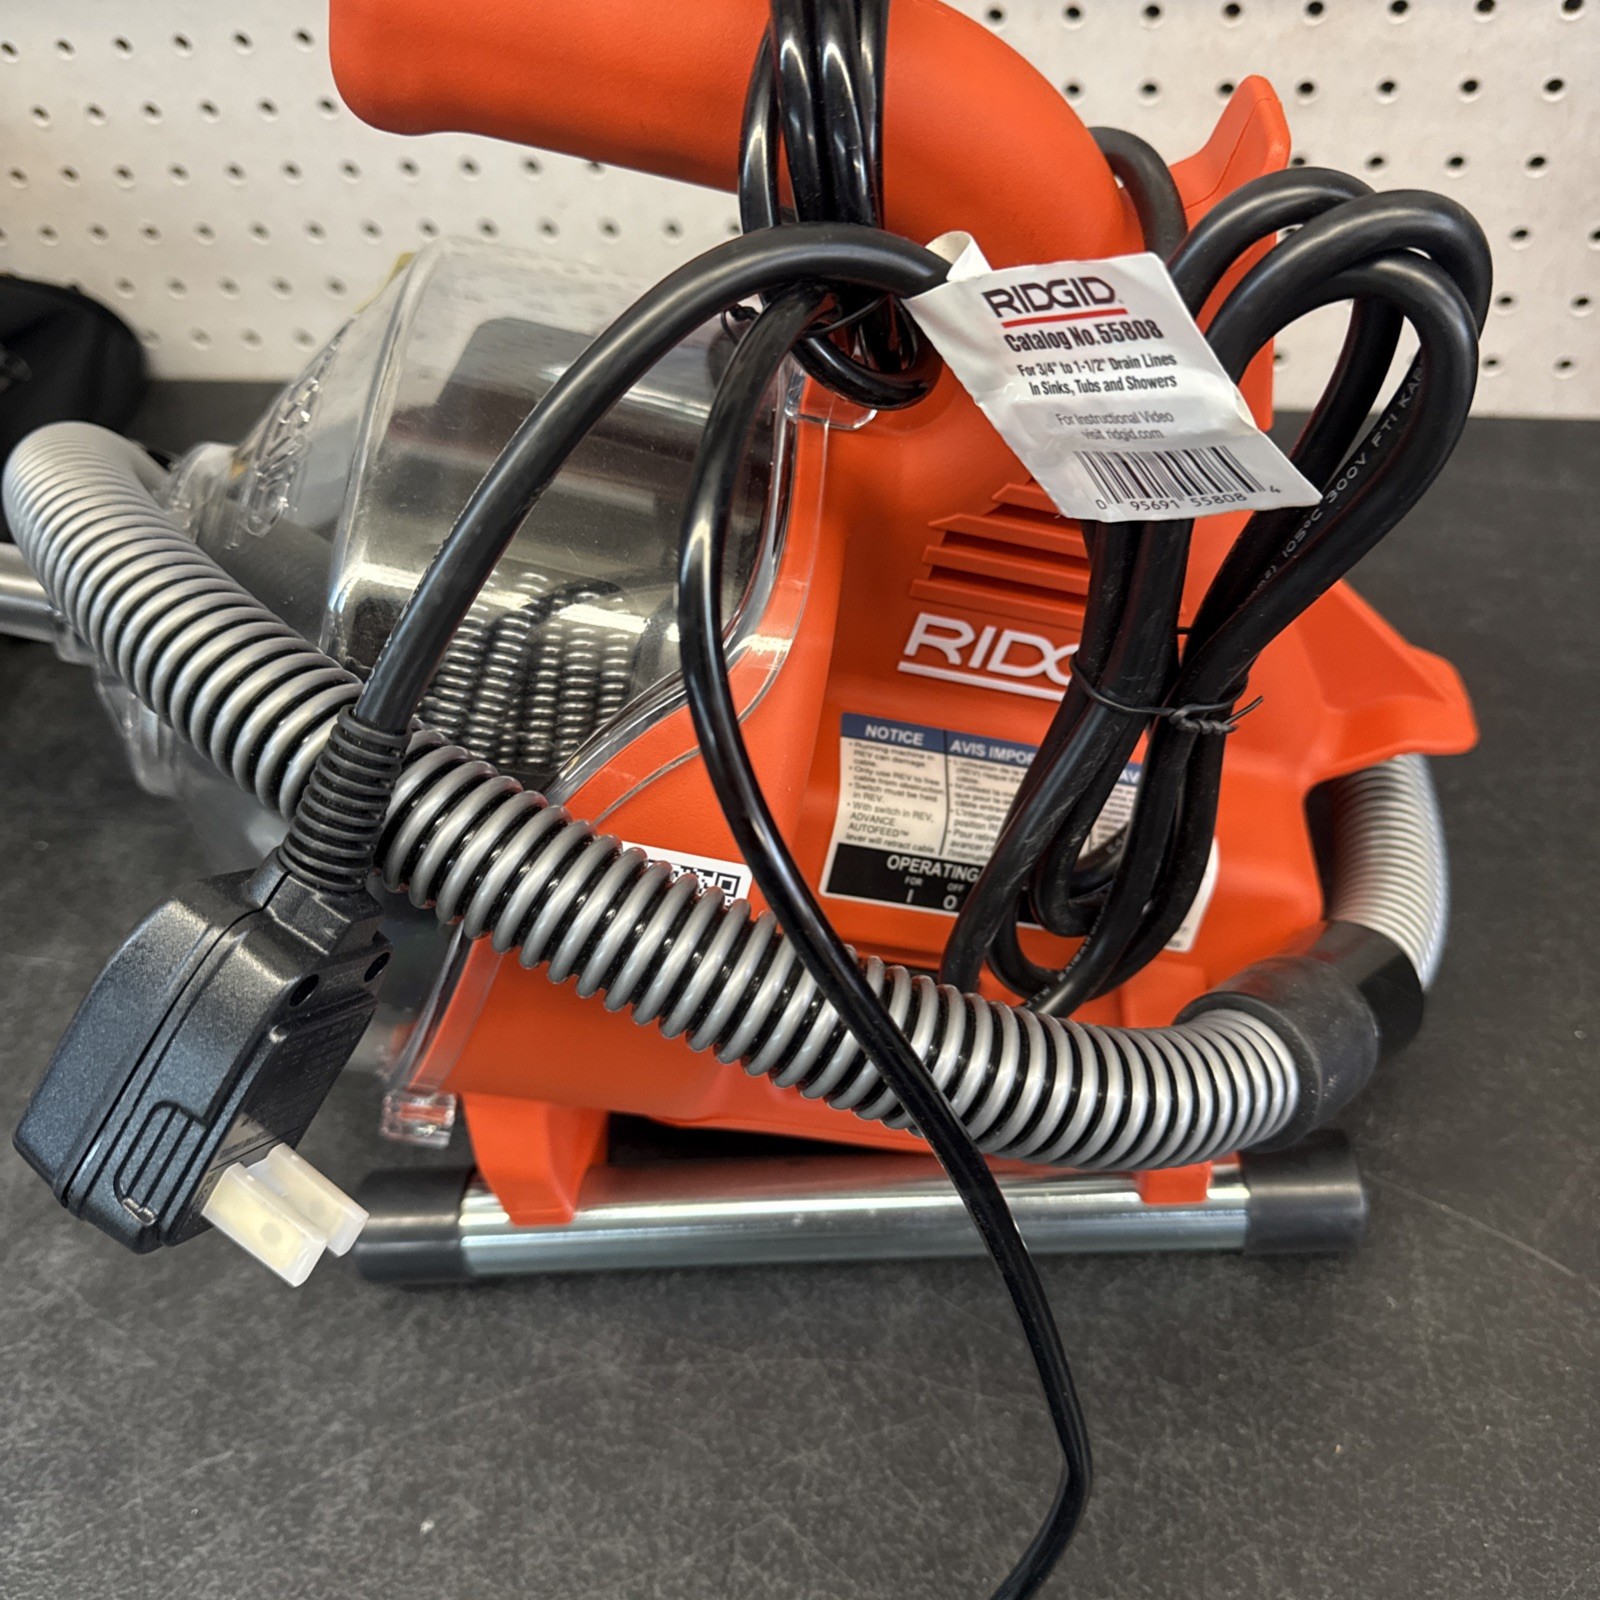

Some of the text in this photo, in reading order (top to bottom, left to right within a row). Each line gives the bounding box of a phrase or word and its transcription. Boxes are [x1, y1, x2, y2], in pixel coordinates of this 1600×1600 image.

[981, 276, 1116, 318] RIDGID
[1003, 330, 1072, 353] Catalog
[1017, 364, 1037, 377] For
[1038, 361, 1058, 376] 3/4"
[1060, 361, 1073, 374] to
[1108, 356, 1140, 371] Drain
[1141, 353, 1177, 368] Lines
[1029, 375, 1177, 396] In Sinks, Tubs and Showers
[1055, 410, 1175, 425] For Instructional Video
[1081, 428, 1164, 441] visit ridgid.com
[1325, 451, 1368, 504] 300V
[1371, 413, 1399, 448] FTI
[1096, 486, 1281, 511] 0 95691 55808 4
[864, 724, 925, 746] NOTICE
[949, 739, 987, 757] AVIS
[850, 812, 896, 827] ADVANCE
[886, 854, 979, 882] OPERATING
[904, 876, 924, 887] FOR
